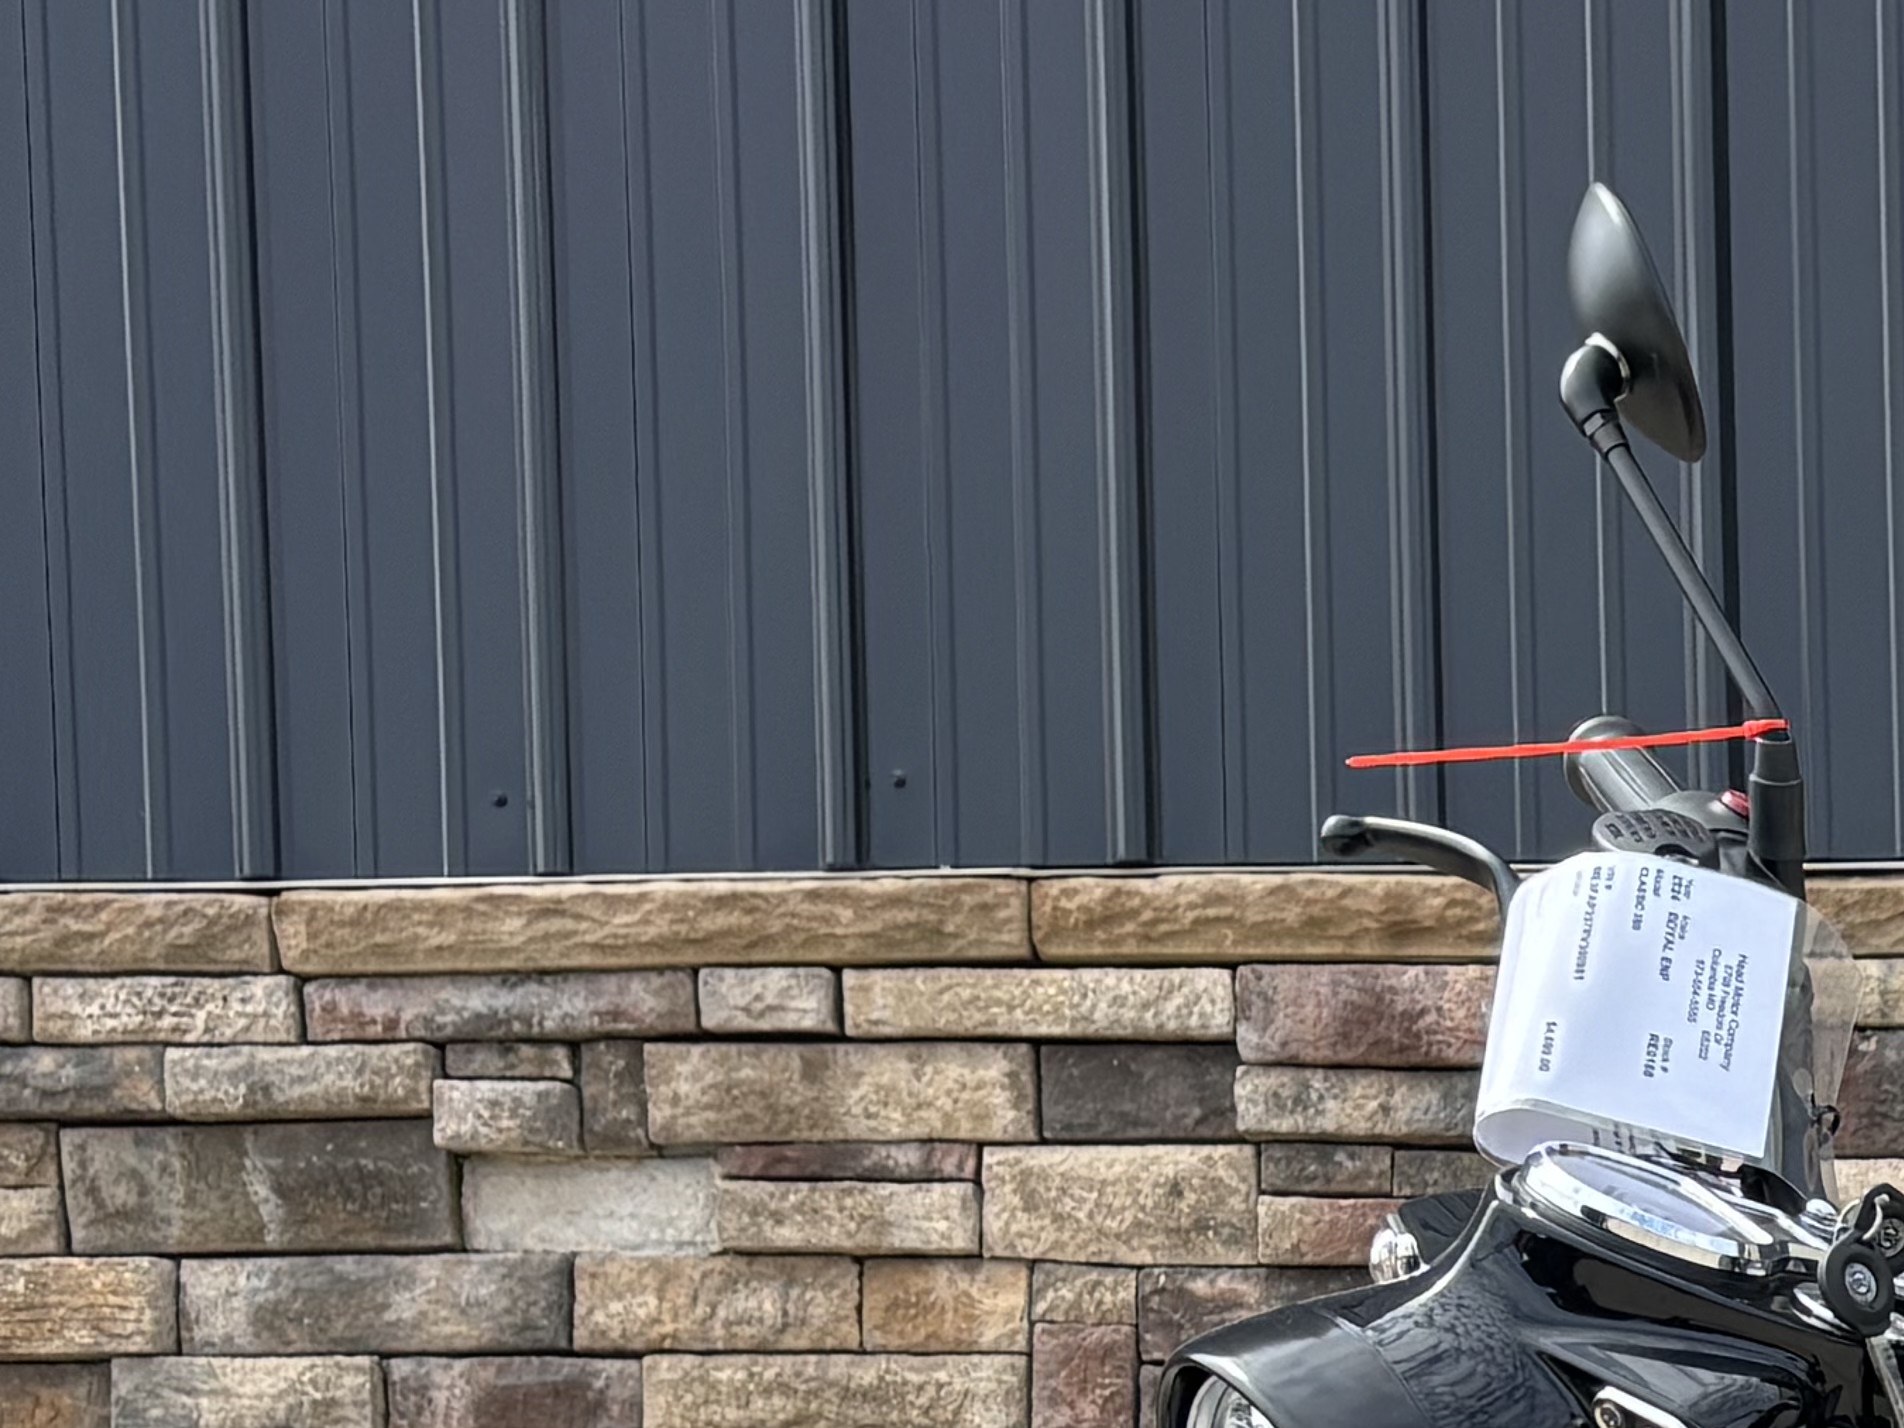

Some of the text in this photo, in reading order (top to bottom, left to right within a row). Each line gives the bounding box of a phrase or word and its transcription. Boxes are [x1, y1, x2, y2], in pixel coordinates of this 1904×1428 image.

[1634, 866, 1650, 911] CLASSIC
[1662, 911, 1679, 953] ROYAL
[1705, 992, 1717, 1011] MO
[1719, 953, 1749, 1072] Head Motor Company
